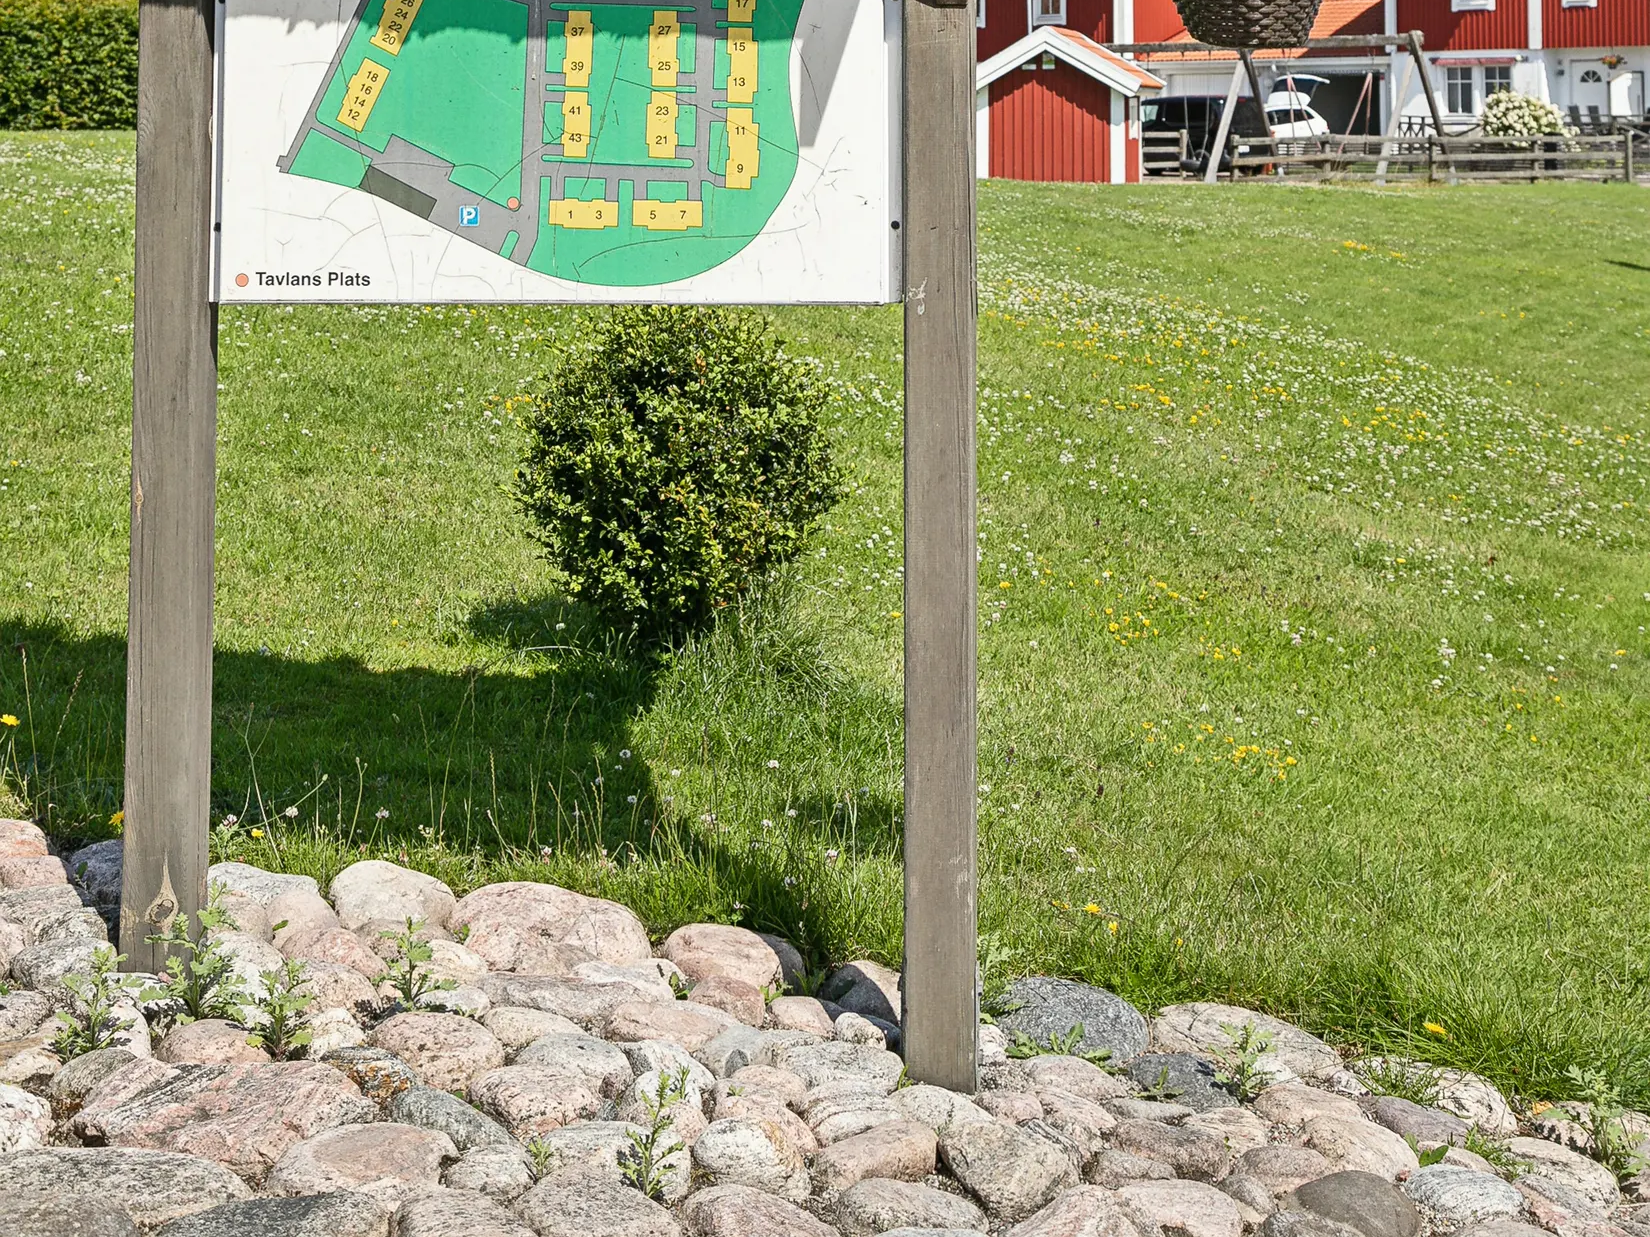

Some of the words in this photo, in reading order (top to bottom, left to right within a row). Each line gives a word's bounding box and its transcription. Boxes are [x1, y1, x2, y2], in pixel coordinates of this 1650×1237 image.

[393, 7, 409, 21] 24
[387, 20, 403, 34] 22
[570, 26, 585, 37] 37
[657, 25, 672, 36] 27
[381, 32, 397, 46] 20
[732, 40, 747, 52] 15
[570, 61, 584, 72] 39
[657, 61, 672, 71] 25
[366, 70, 379, 83] 18
[732, 76, 747, 87] 13
[360, 83, 373, 96] 16
[353, 96, 366, 108] 14
[347, 108, 361, 121] 12
[568, 105, 581, 115] 41
[655, 105, 670, 116] 23
[734, 126, 746, 136] 11
[568, 132, 582, 143] 43
[655, 135, 668, 145] 21
[462, 207, 477, 225] P
[256, 272, 321, 286] Tavlans
[329, 272, 370, 286] Plats
